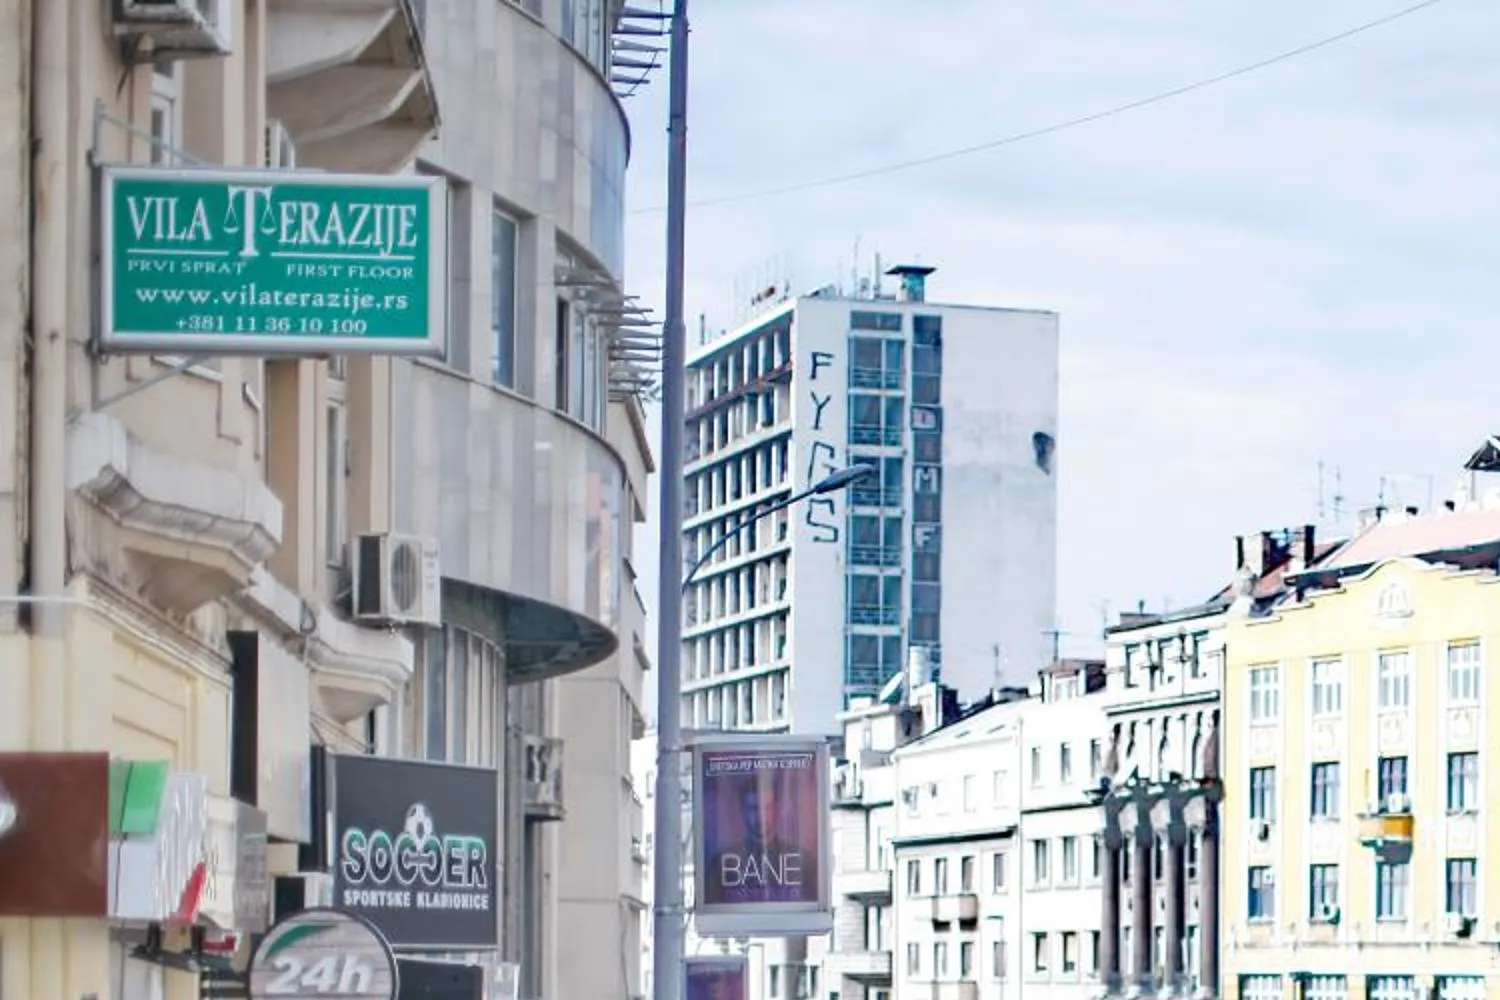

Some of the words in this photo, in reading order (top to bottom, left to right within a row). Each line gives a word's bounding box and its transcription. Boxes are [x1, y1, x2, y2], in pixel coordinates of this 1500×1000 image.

[126, 196, 213, 242] VILA
[226, 184, 418, 257] TERAZIJE
[127, 259, 176, 274] PRVI
[181, 260, 247, 276] SPRAT
[286, 263, 343, 278] FIRST
[348, 265, 415, 279] FLOOR
[135, 283, 409, 315] www.vilaterazije.rs
[175, 315, 225, 332] +381
[235, 316, 257, 333] 11
[265, 317, 291, 334] 36
[300, 318, 323, 334] 10
[331, 318, 368, 335] 100
[342, 829, 488, 889] SOCCER
[720, 853, 803, 887] BANE
[343, 889, 411, 908] SPORTSKE
[416, 891, 490, 910] KLADIONICE
[264, 951, 374, 996] 24h
